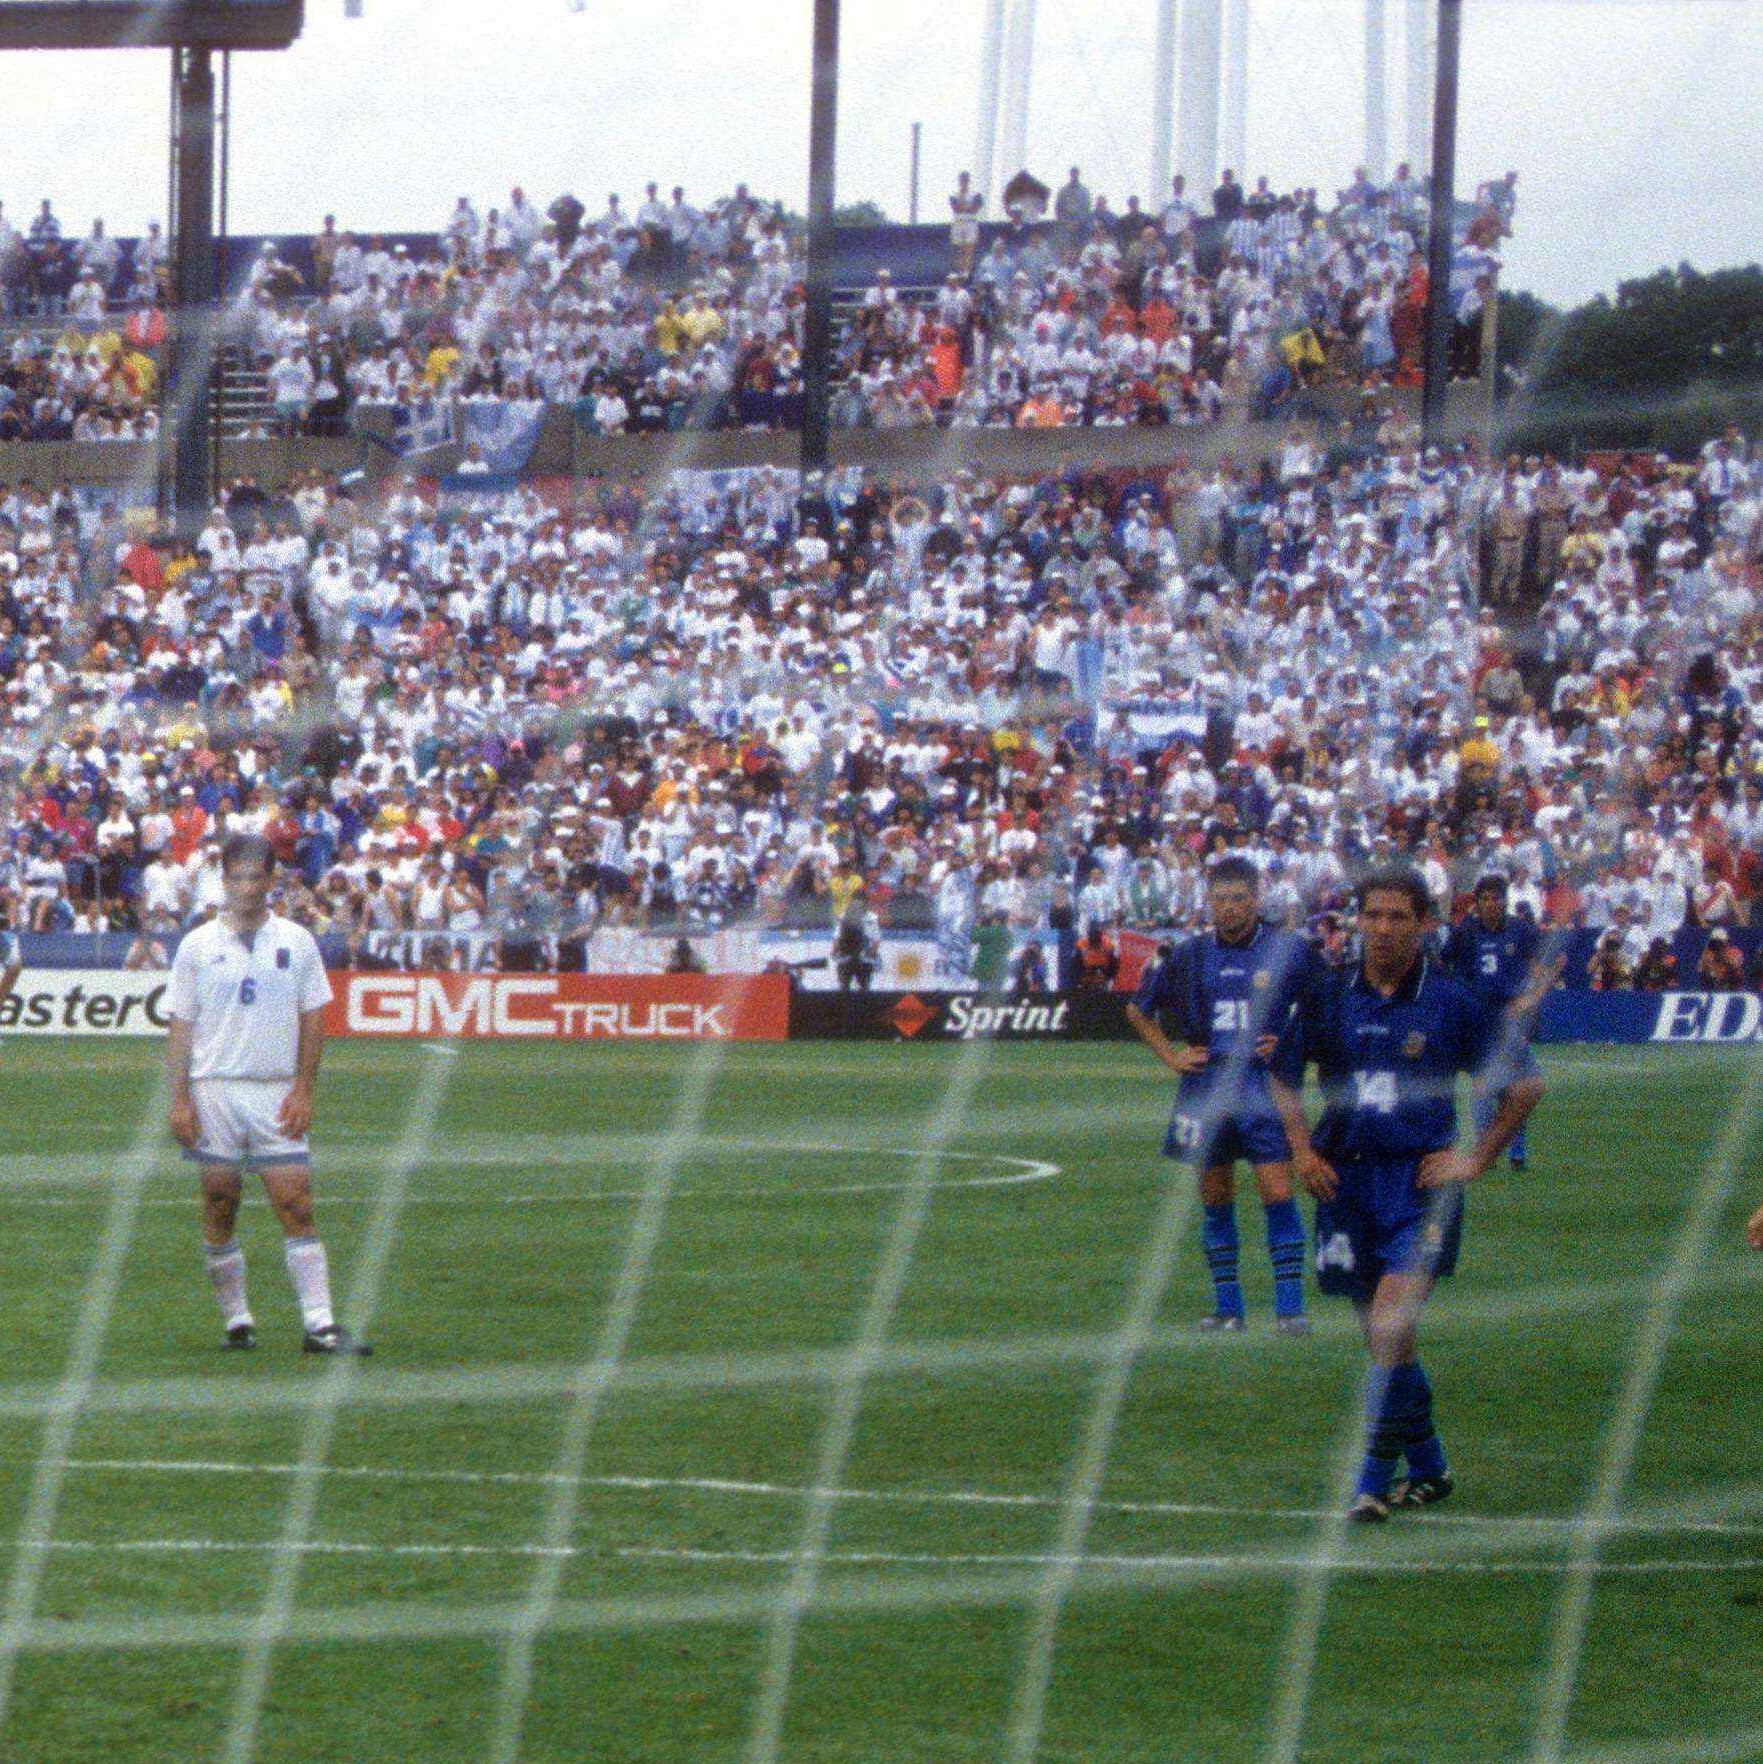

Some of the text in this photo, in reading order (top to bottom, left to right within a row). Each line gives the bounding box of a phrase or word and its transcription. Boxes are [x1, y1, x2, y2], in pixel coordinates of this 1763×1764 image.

[1481, 954, 1498, 975] 3
[239, 978, 256, 1005] 6
[347, 976, 727, 1035] GMC TRUCK
[945, 996, 1070, 1040] Sprint
[1212, 1001, 1248, 1031] 21
